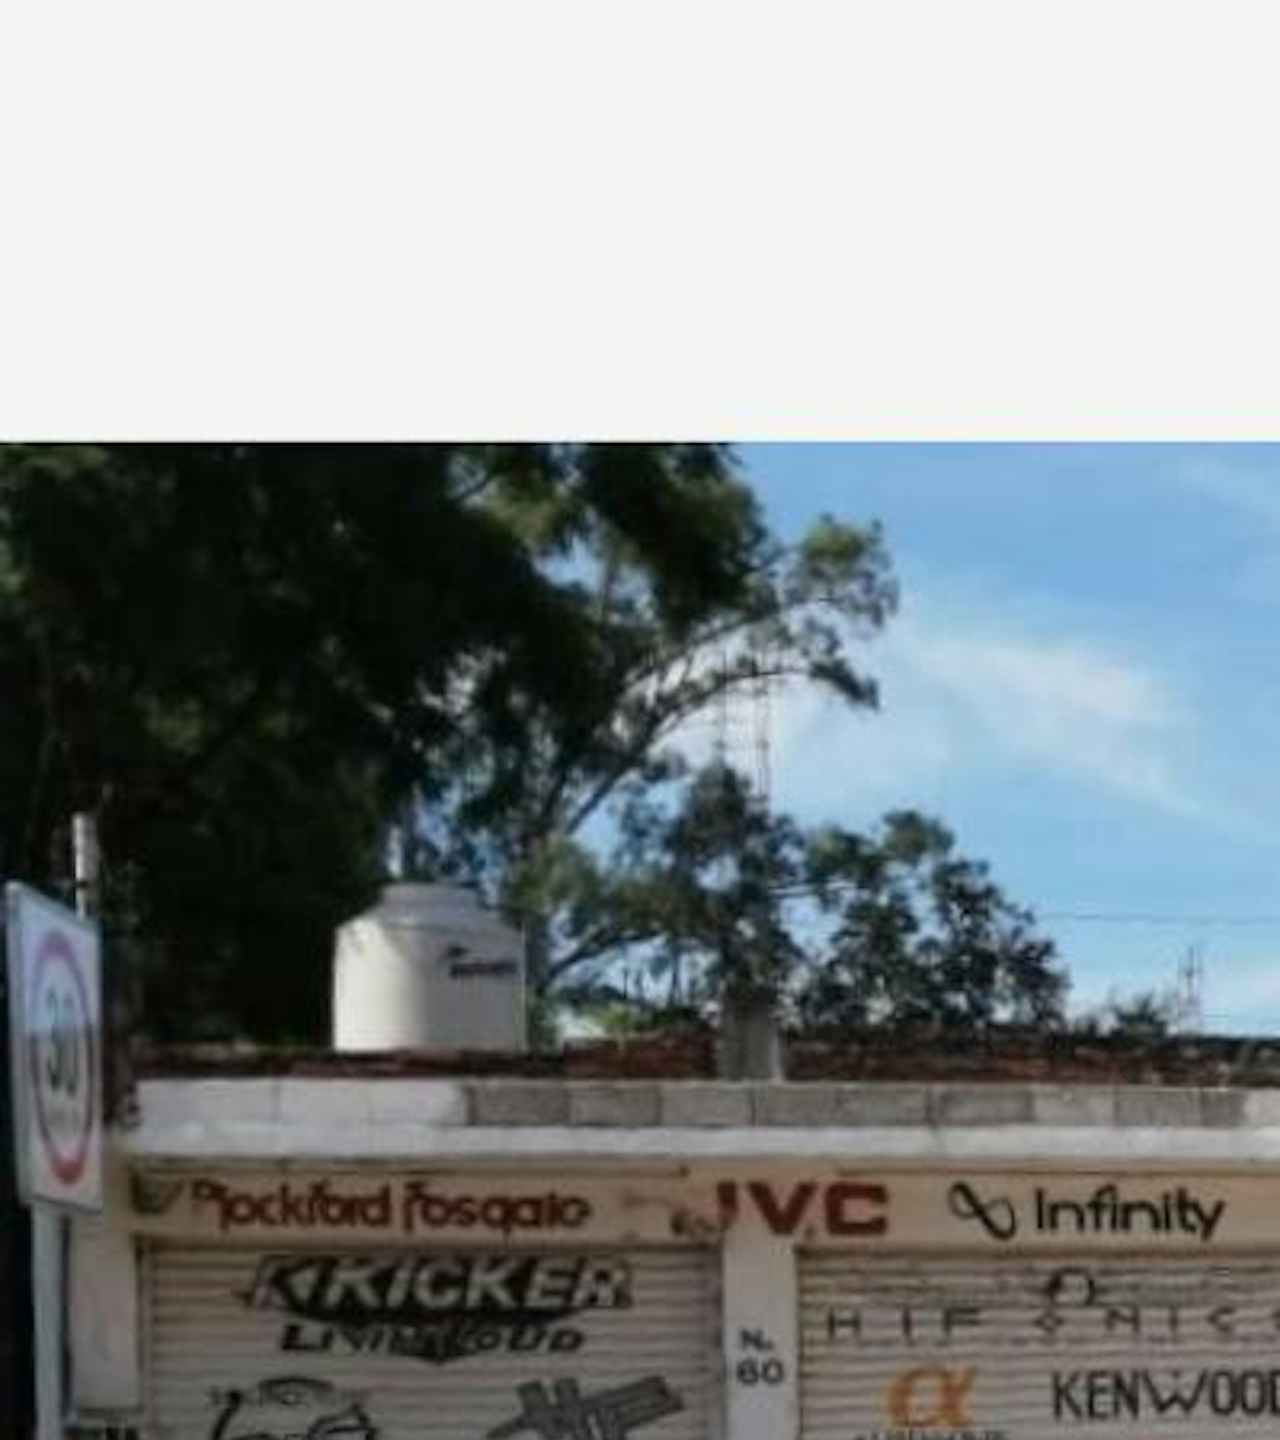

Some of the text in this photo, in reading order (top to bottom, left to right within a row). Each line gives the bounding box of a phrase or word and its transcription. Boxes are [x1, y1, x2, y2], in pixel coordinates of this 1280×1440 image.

[714, 1180, 890, 1237] JVC
[1035, 1184, 1226, 1239] Infinity
[736, 1357, 784, 1388] 60
